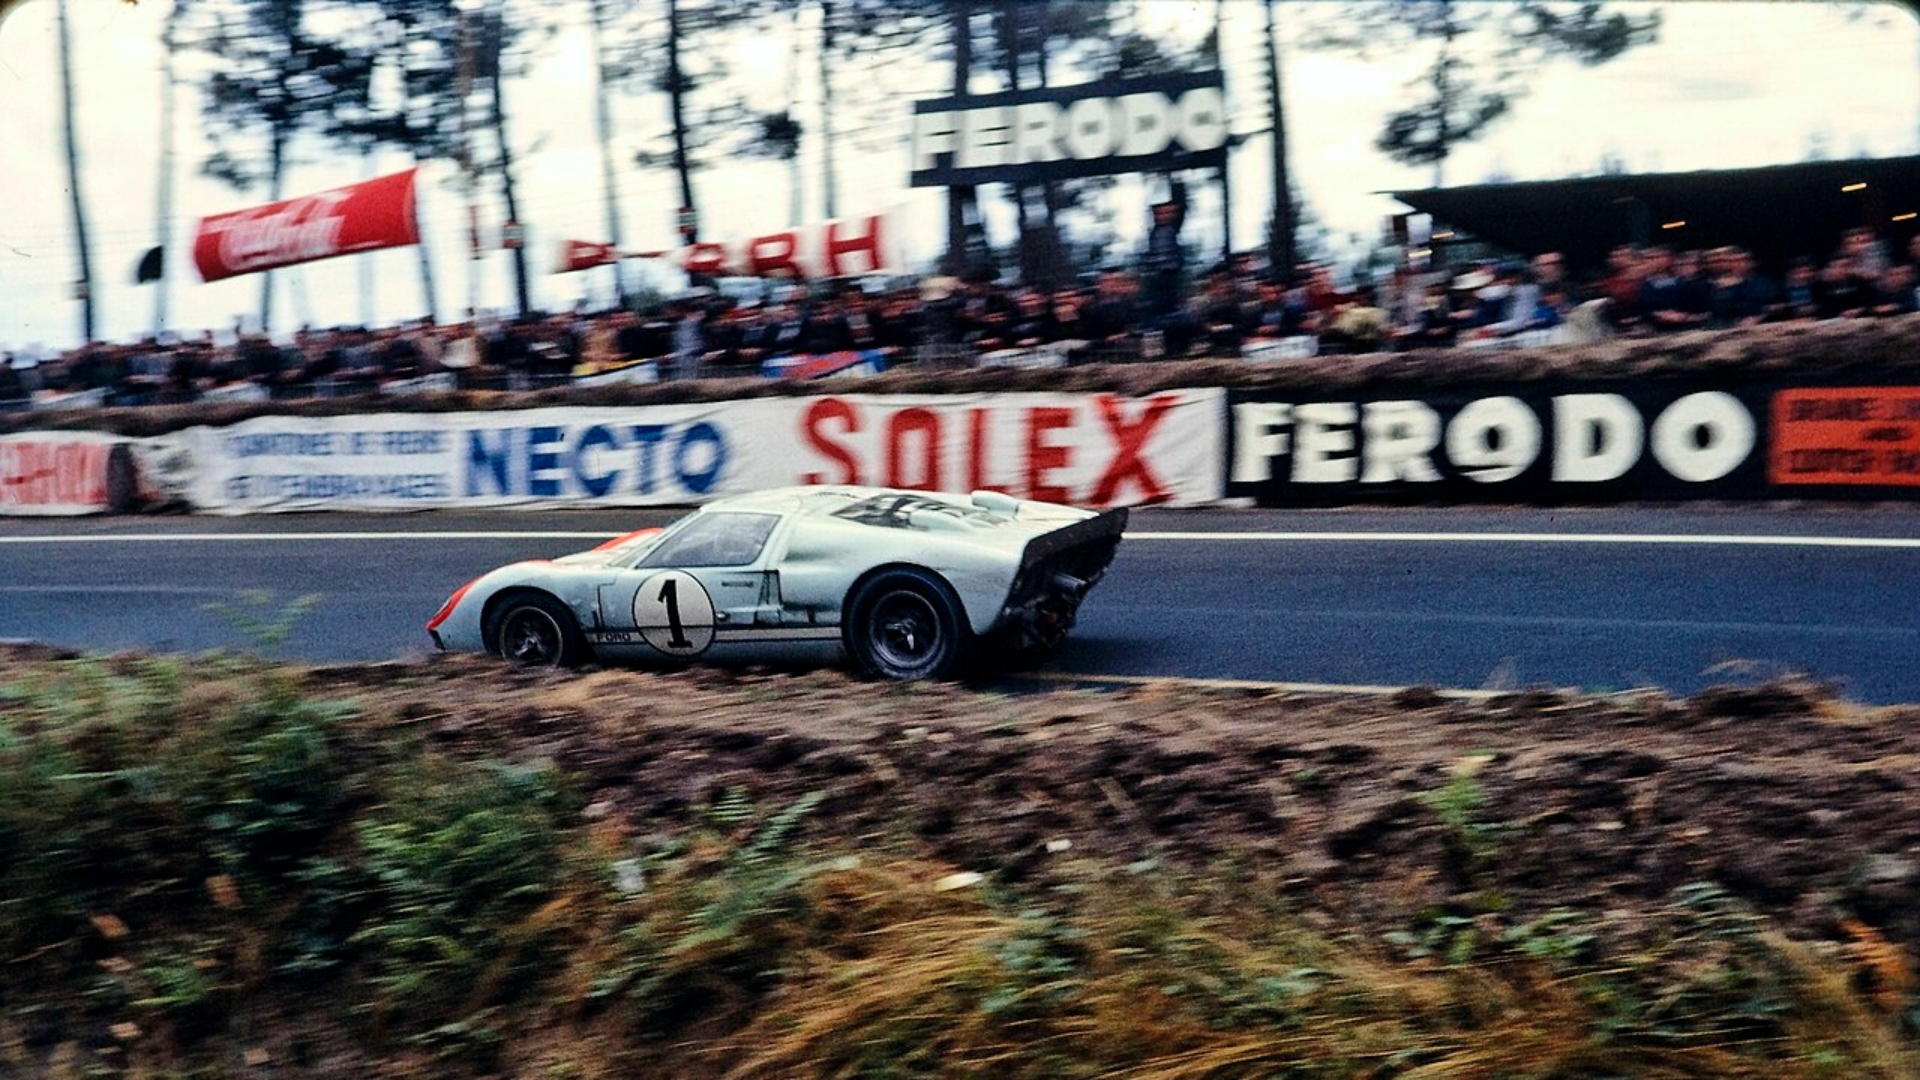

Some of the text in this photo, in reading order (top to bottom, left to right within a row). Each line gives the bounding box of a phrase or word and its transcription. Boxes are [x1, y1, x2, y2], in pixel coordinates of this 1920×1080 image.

[914, 86, 1228, 171] FERODO
[464, 421, 729, 496] NECTO
[797, 396, 1178, 507] SOLEX
[1231, 391, 1756, 482] FERODO
[657, 579, 693, 648] 1
